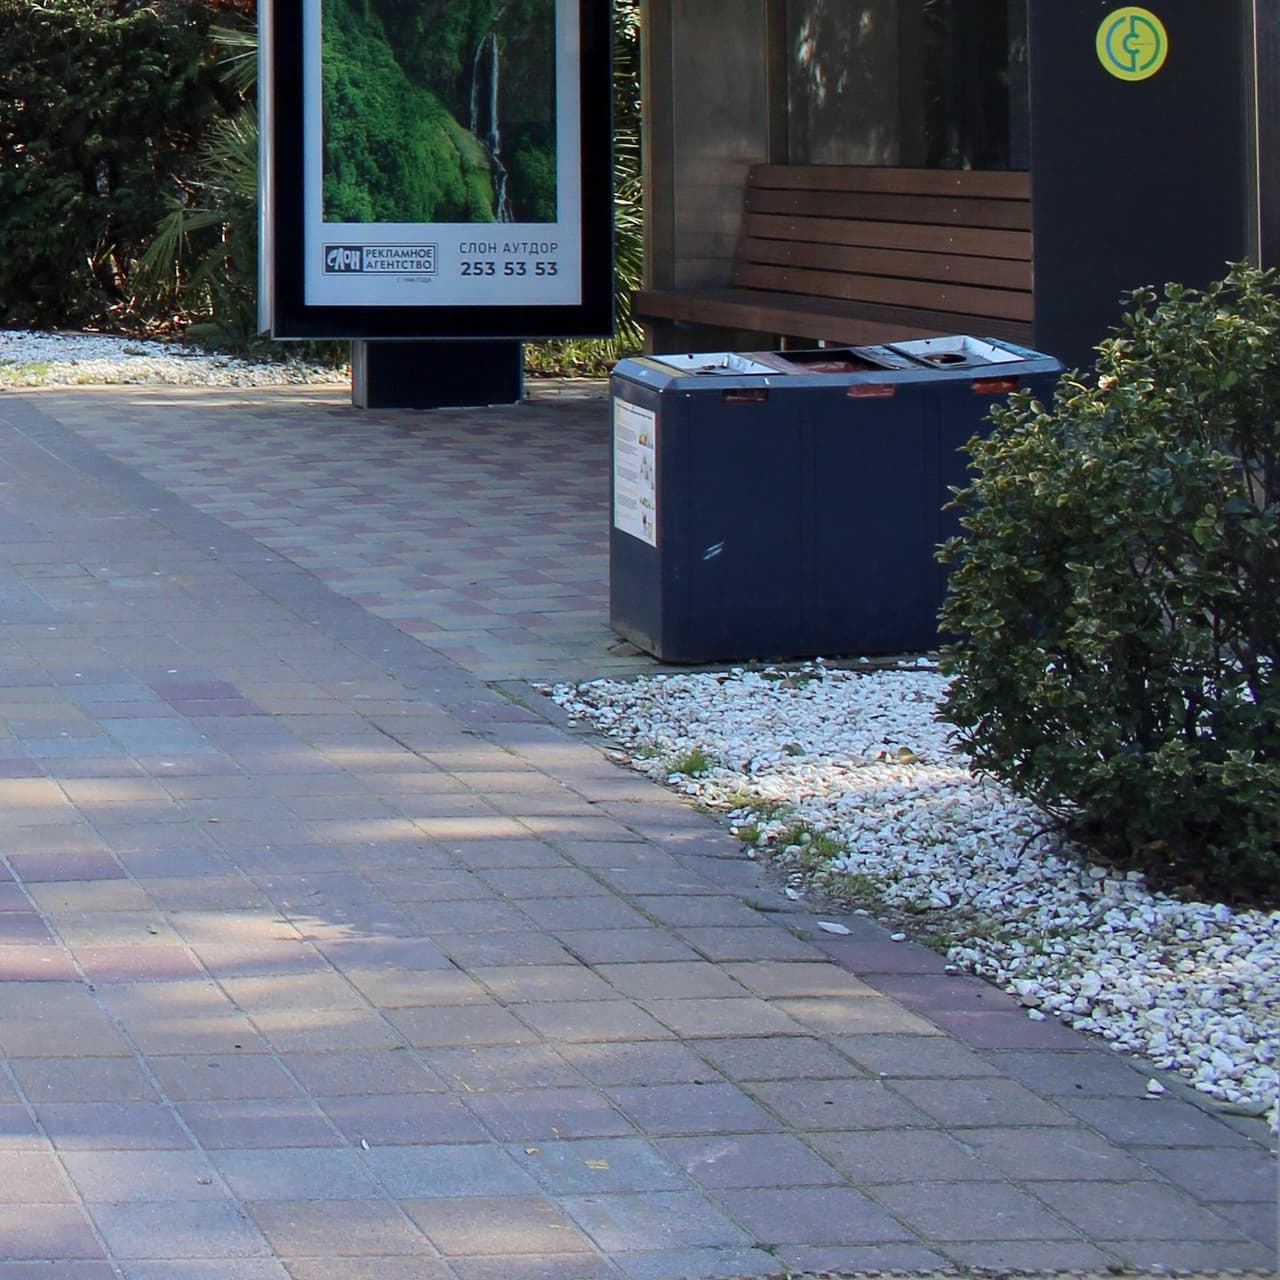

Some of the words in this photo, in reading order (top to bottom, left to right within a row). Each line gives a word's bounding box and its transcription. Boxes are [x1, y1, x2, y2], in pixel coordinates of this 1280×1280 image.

[365, 248, 433, 258] РЕКЛАМНОЕ
[459, 242, 497, 254] СЛОН
[503, 242, 559, 255] АУТДОР
[366, 260, 432, 270] АГЕНТСТВО
[460, 261, 496, 276] 253
[503, 261, 527, 276] 53
[535, 261, 559, 276] 53
